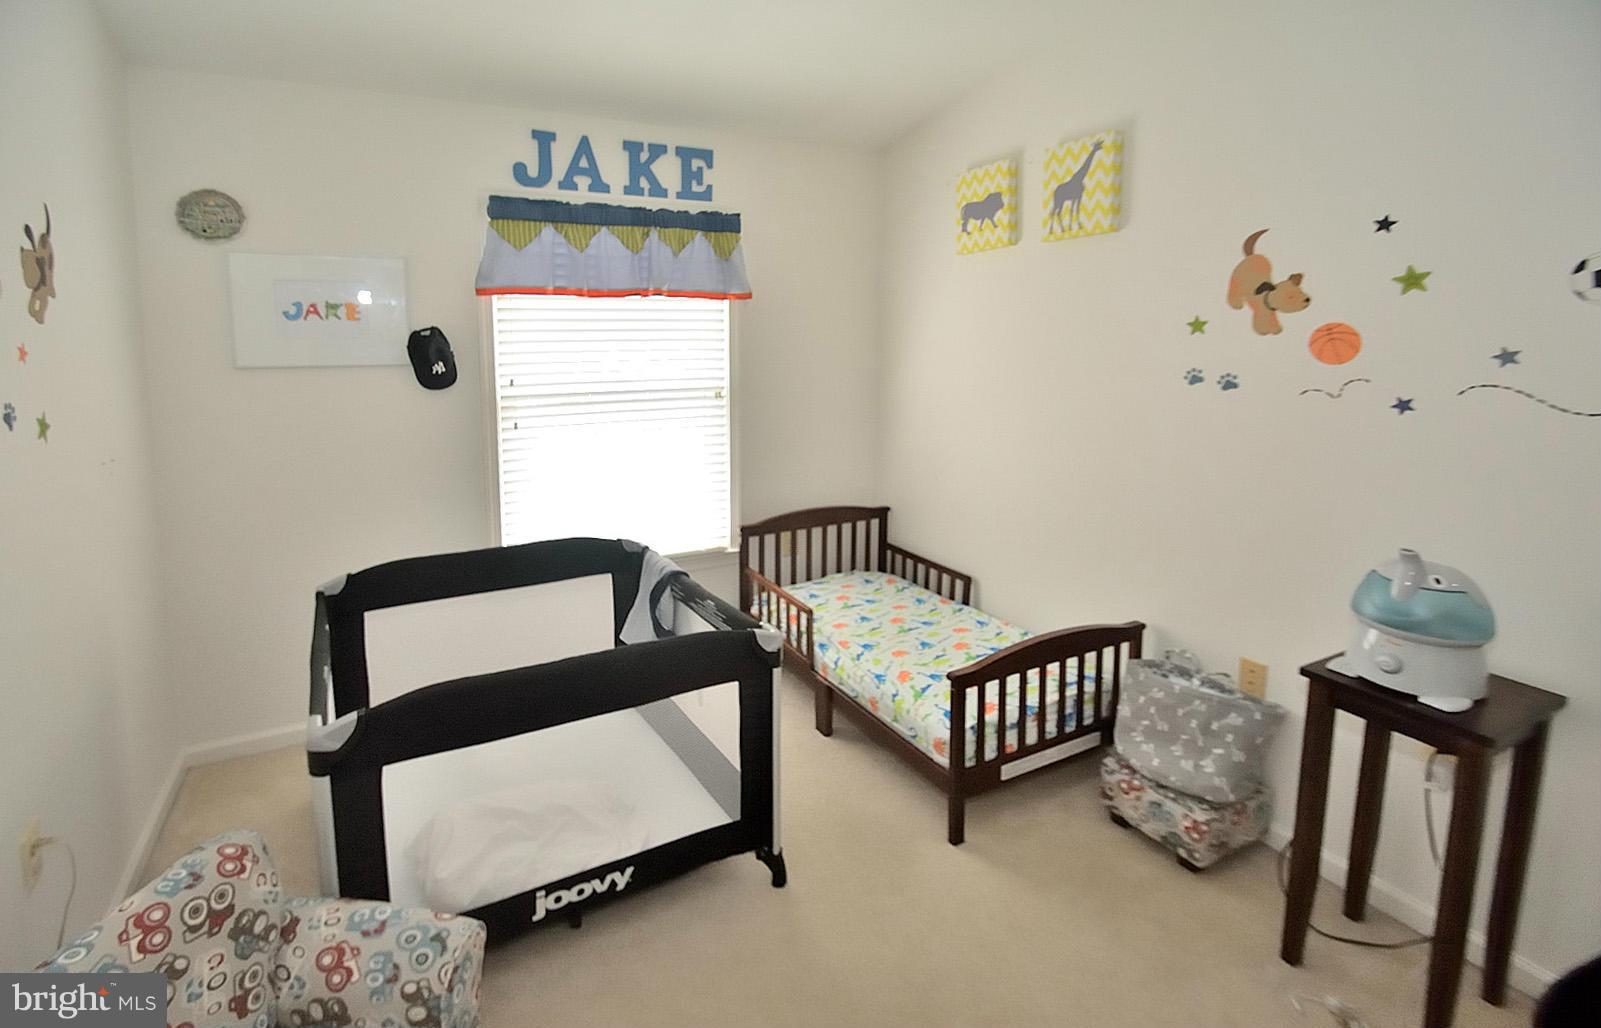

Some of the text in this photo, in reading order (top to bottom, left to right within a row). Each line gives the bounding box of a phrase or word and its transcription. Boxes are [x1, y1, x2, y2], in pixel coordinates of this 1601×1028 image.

[513, 129, 714, 202] JAKE
[282, 300, 361, 321] JAKE
[531, 865, 636, 923] joovy
